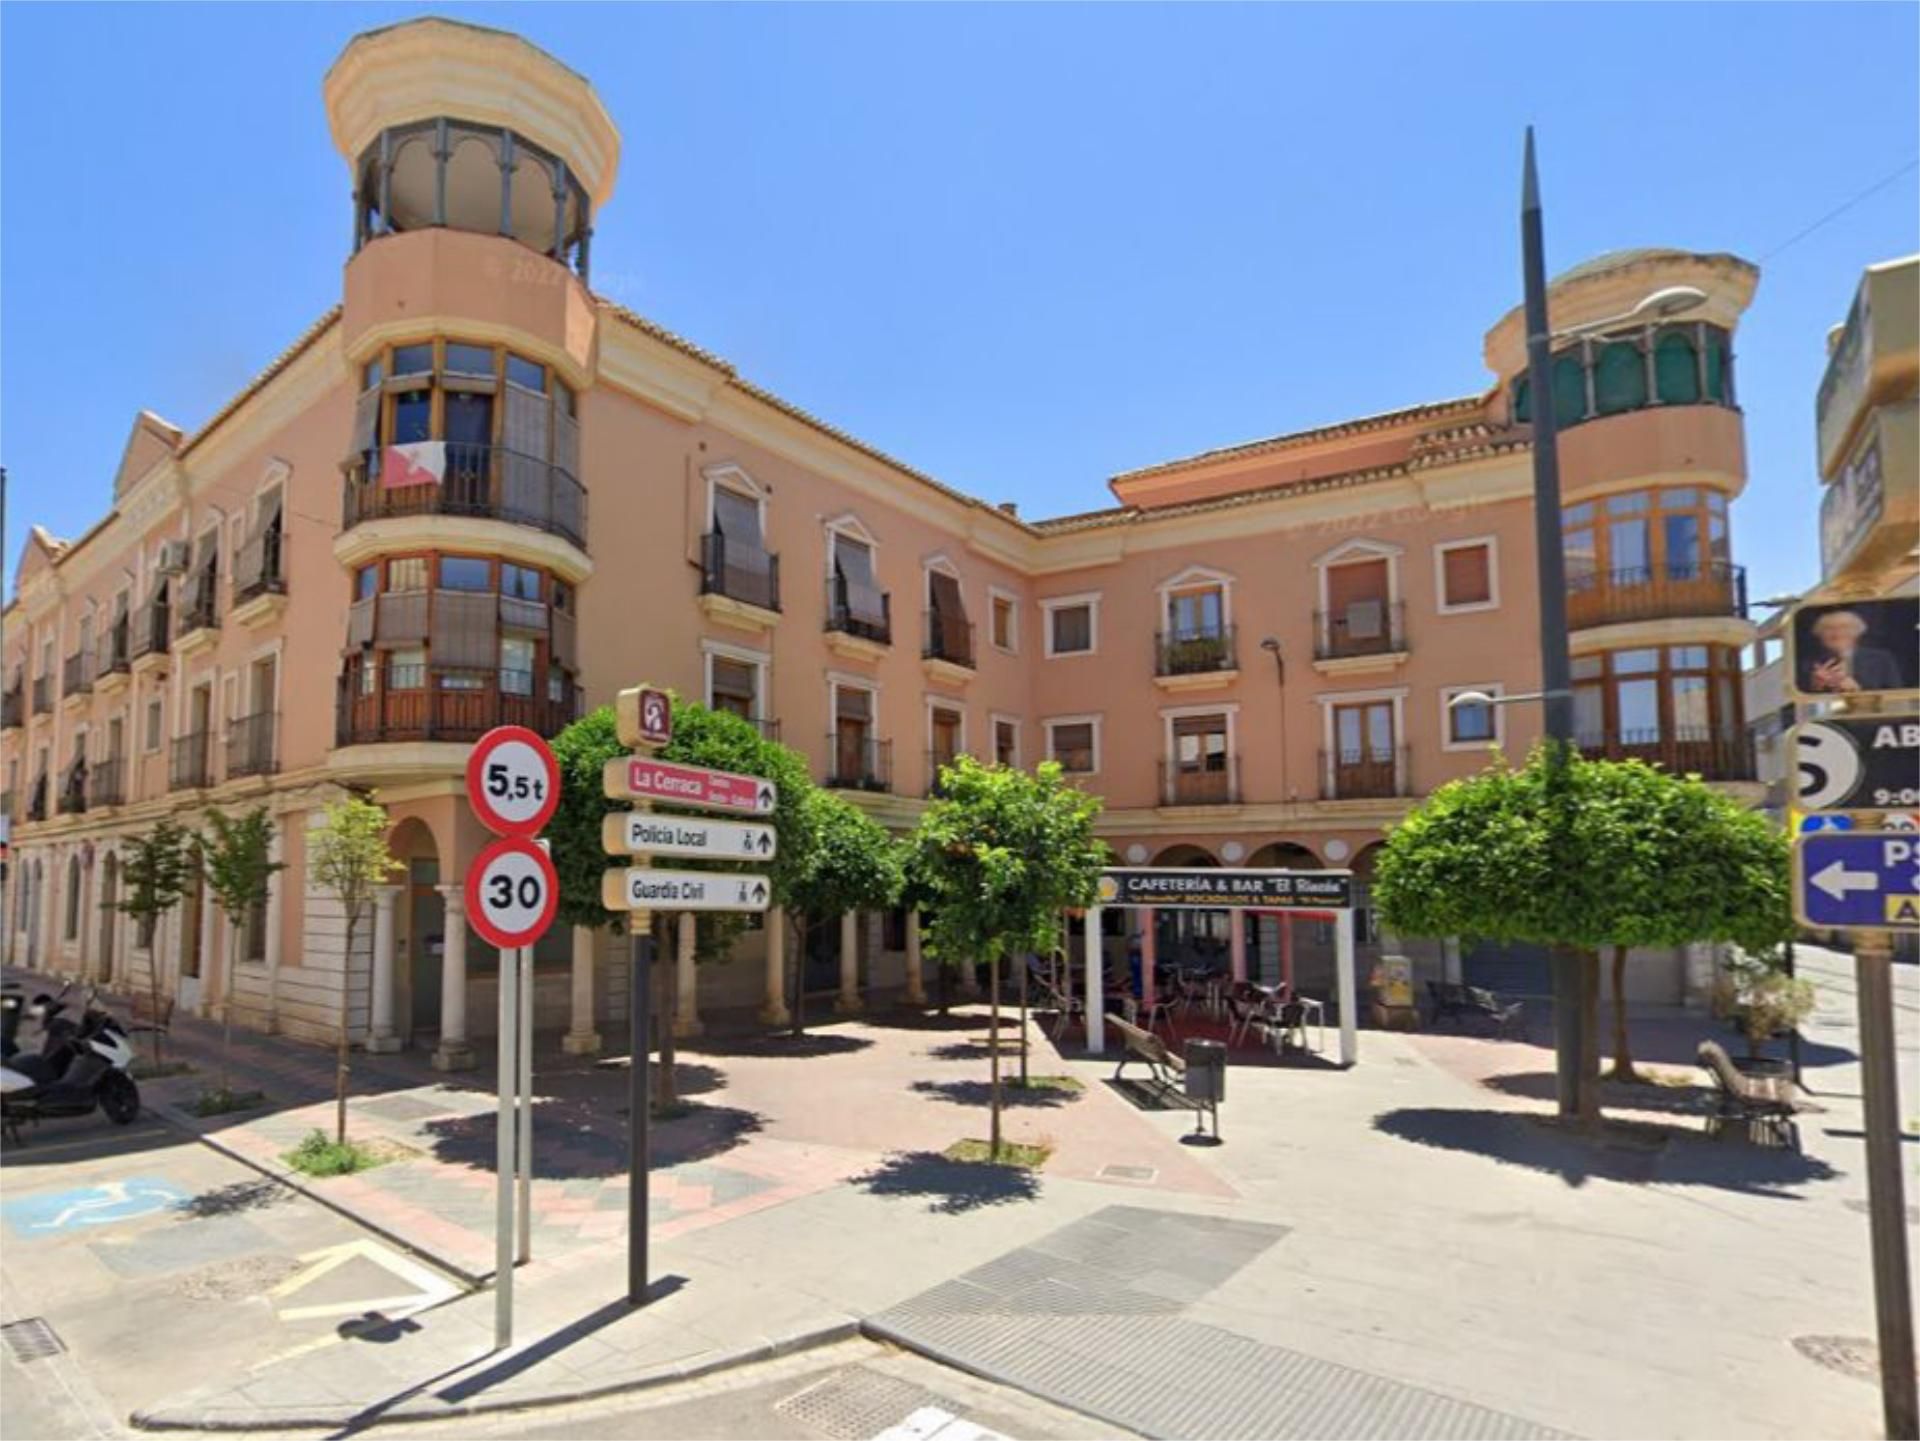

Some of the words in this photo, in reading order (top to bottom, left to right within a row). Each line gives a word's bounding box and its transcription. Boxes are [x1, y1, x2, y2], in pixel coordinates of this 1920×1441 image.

[634, 767, 651, 788] La
[677, 827, 707, 847] Local
[1884, 840, 1919, 867] P
[489, 874, 540, 909] 30
[632, 880, 679, 900] Guardia
[681, 881, 704, 900] Civil
[1128, 875, 1212, 891] CAFETERÍA
[1232, 879, 1264, 892] BAR
